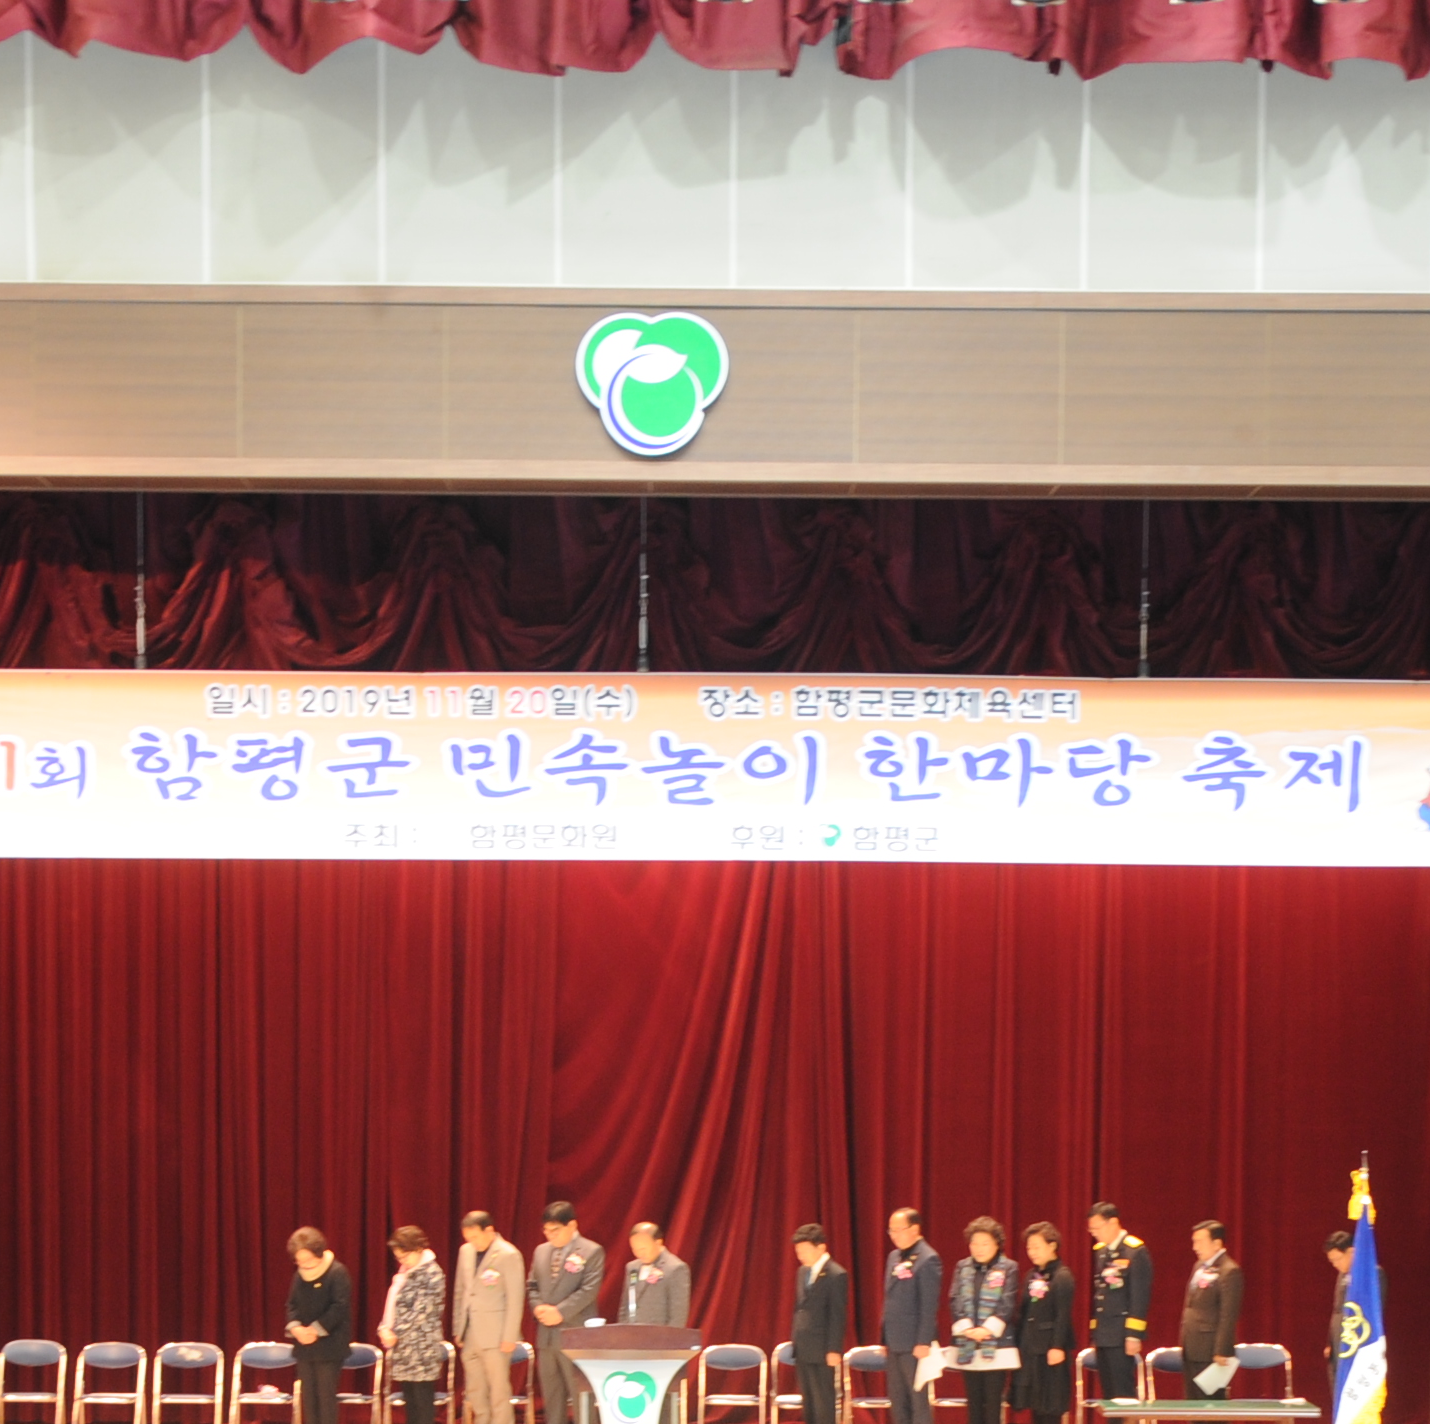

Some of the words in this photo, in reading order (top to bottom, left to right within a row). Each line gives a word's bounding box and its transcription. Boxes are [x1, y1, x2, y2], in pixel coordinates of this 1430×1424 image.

[207, 684, 268, 715] 일시
[300, 685, 412, 717] 2019년
[426, 685, 495, 717] 11월
[508, 685, 636, 719] 20일(수)
[702, 687, 760, 718] 장소
[793, 687, 1078, 720] 함평군문화체육센터
[129, 731, 412, 802] 함평군
[449, 732, 820, 808] 민속놀이
[863, 735, 1155, 809] 한마당
[1179, 738, 1365, 814] 축제
[344, 823, 399, 849] 주최
[470, 823, 618, 851] 함평문화원
[730, 824, 785, 851] 후원
[852, 825, 940, 853] 함평군
